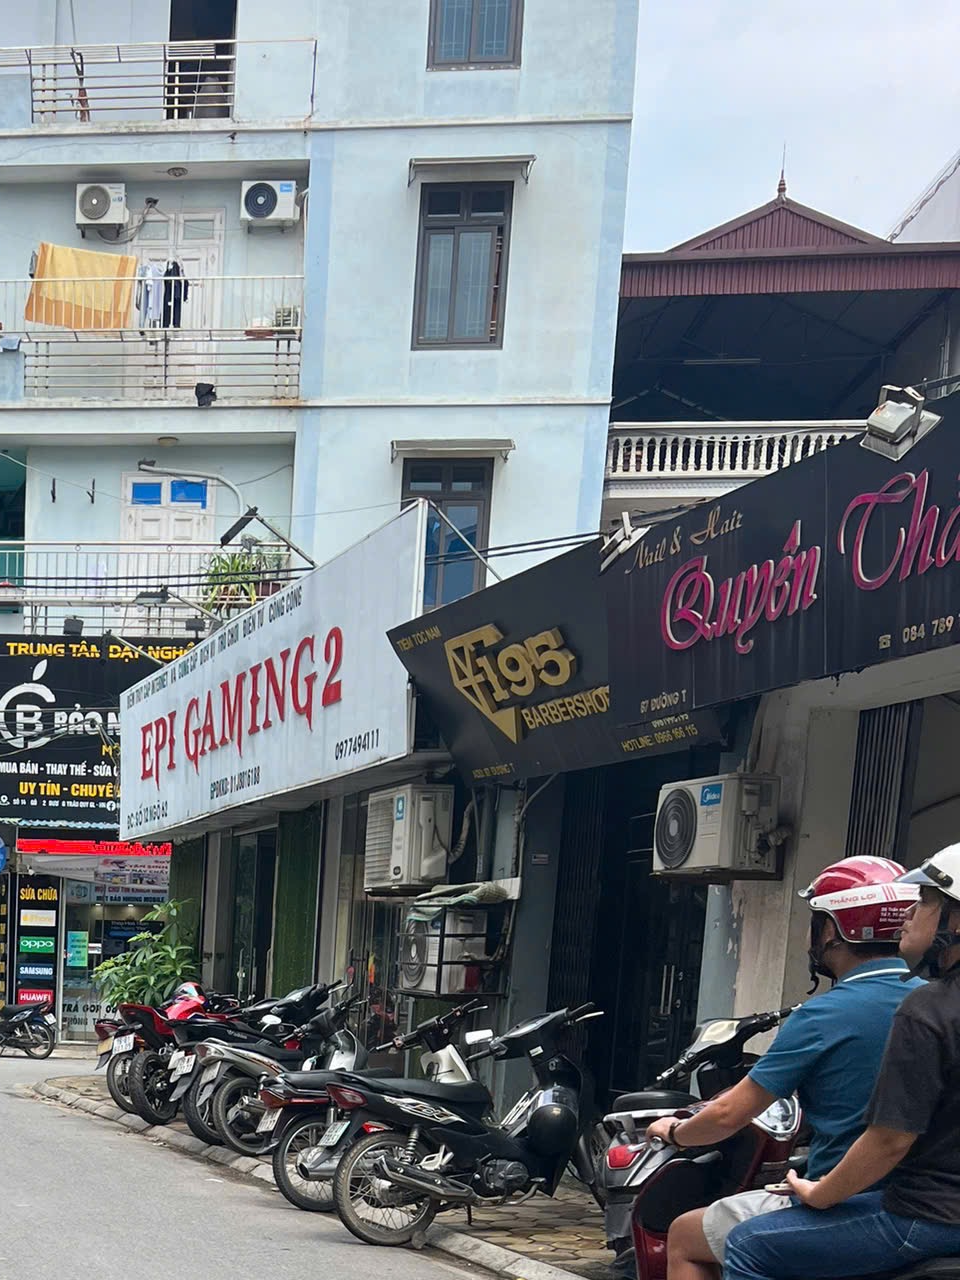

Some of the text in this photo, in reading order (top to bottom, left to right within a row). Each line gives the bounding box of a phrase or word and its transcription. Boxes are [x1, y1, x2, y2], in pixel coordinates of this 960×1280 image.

[624, 505, 744, 574] Nail & Hair
[902, 615, 954, 644] 084 789
[6, 642, 65, 656] TRUNG
[148, 642, 194, 659] NGH
[54, 704, 102, 734] BẢO
[141, 711, 176, 791] EPI
[335, 728, 380, 760] 0977494111
[621, 735, 654, 752] HOTLINE:
[20, 760, 38, 774] BÁN
[46, 764, 68, 776] THAY
[70, 760, 86, 776] THẾ
[93, 761, 112, 776] SỬA
[20, 782, 37, 794] UY
[39, 780, 60, 796] TÍN
[20, 884, 58, 900] SỬA CHỮA
[20, 966, 53, 976] SAMSUNG
